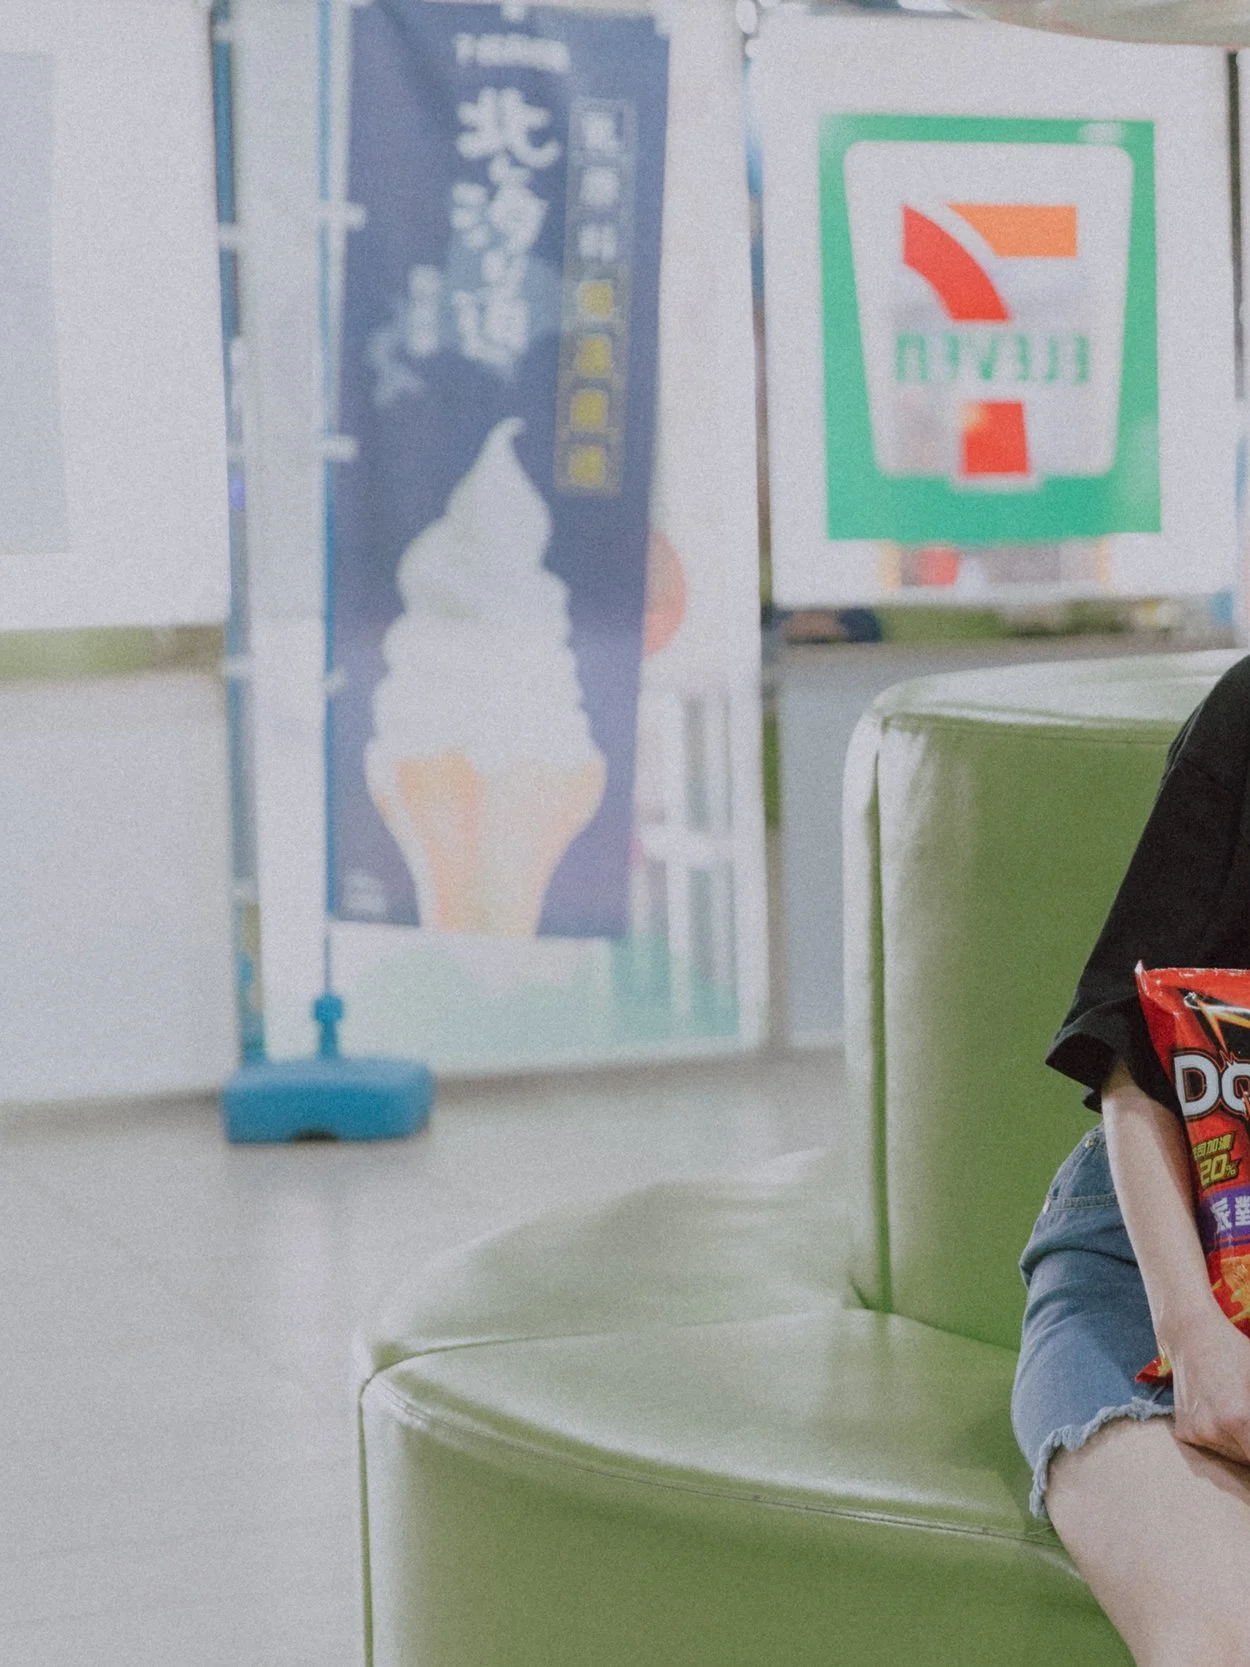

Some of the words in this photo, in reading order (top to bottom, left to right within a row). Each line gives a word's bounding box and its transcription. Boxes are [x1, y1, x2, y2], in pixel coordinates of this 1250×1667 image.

[1193, 1133, 1234, 1158] 司加濃
[1200, 1153, 1238, 1187] 20%
